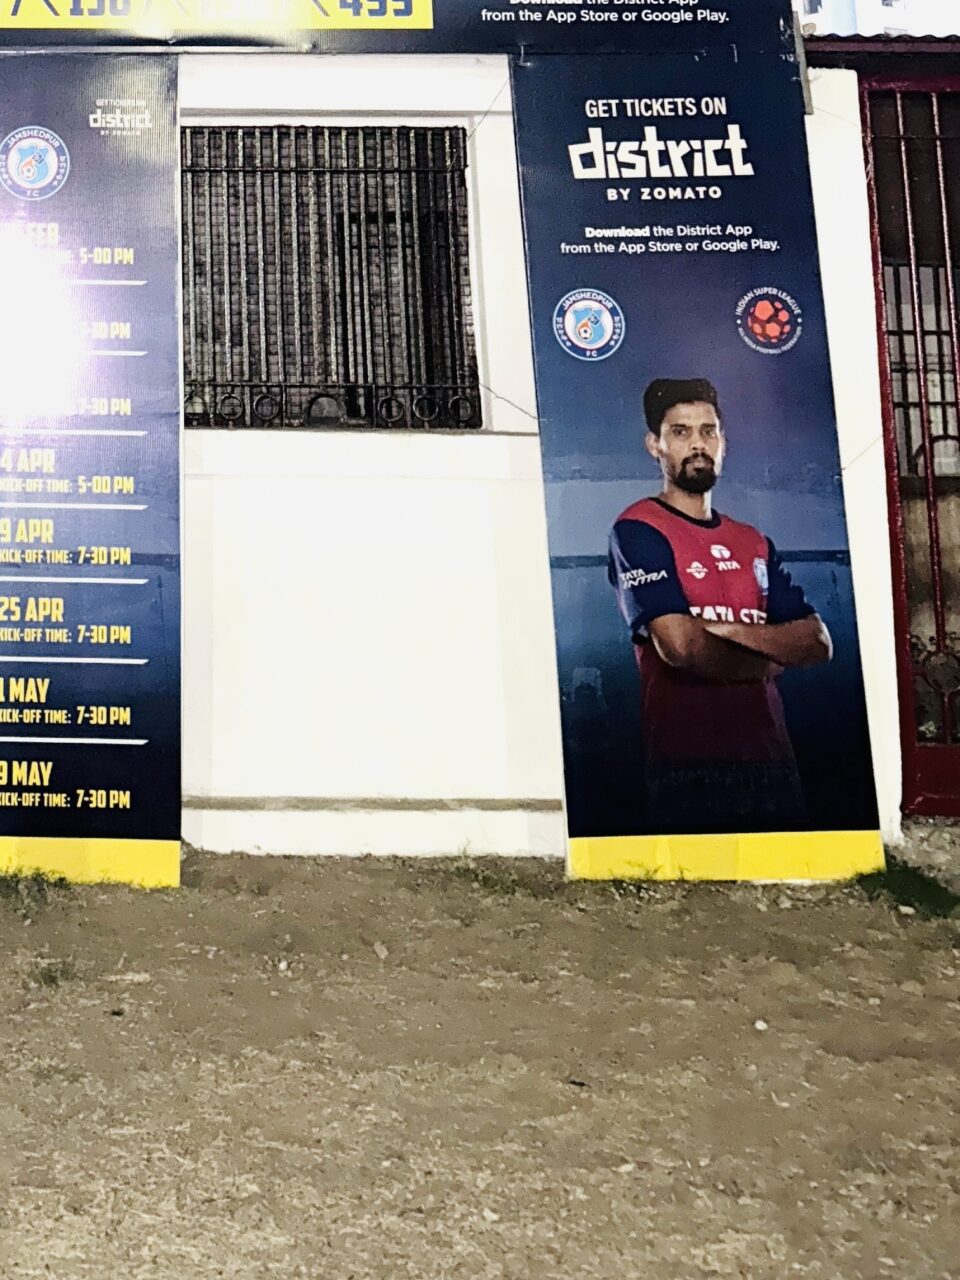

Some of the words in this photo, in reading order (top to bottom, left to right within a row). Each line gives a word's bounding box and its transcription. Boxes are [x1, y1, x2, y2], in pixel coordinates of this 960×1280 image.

[481, 9, 515, 21] from
[519, 9, 542, 21] the
[546, 9, 577, 24] App
[580, 9, 618, 22] Store
[622, 11, 637, 22] or
[641, 9, 693, 24] Google
[697, 9, 730, 24] Play.
[585, 98, 619, 118] GET
[622, 97, 697, 117] TICKETS
[701, 97, 727, 115] ON
[7, 129, 60, 148] JAMSHEDPUR
[568, 124, 755, 180] district
[607, 188, 631, 201] BY
[640, 186, 722, 200] ZOMATO
[585, 226, 650, 238] Download
[653, 225, 674, 237] the
[677, 224, 722, 236] District
[725, 224, 752, 238] App
[114, 248, 134, 264] PM
[560, 242, 591, 254] from
[594, 242, 615, 253] the
[618, 242, 646, 255] App
[648, 241, 683, 253] Store
[686, 242, 699, 252] or
[702, 239, 748, 253] Google
[751, 238, 780, 252] Play.
[562, 292, 614, 310] JAMSHEDPUR
[735, 291, 754, 315] INDIAN
[753, 287, 778, 296] SUPER
[778, 290, 801, 315] LEAGUE
[110, 322, 130, 339] PM
[111, 398, 131, 415] PM
[0, 448, 12, 472] 4
[17, 448, 56, 473] APR
[46, 479, 72, 494] TIME:
[78, 476, 111, 494] 5-00
[114, 476, 134, 494] PM
[15, 518, 54, 544] APR
[46, 549, 73, 564] TIME:
[78, 546, 107, 564] 7-30
[110, 547, 131, 565] PM
[619, 568, 646, 581] TATA
[623, 570, 668, 589] INTRA
[25, 597, 64, 623] APR
[45, 628, 72, 643] TIME:
[77, 625, 107, 643] 7-30
[110, 625, 131, 644] PM
[9, 678, 50, 703] MAY
[44, 709, 71, 724] TIME:
[76, 706, 106, 725] 7-30
[110, 707, 131, 725] PM
[12, 761, 53, 786] MAY
[43, 792, 71, 807] TIME:
[76, 790, 106, 808] 7-30
[109, 791, 131, 808] PM
